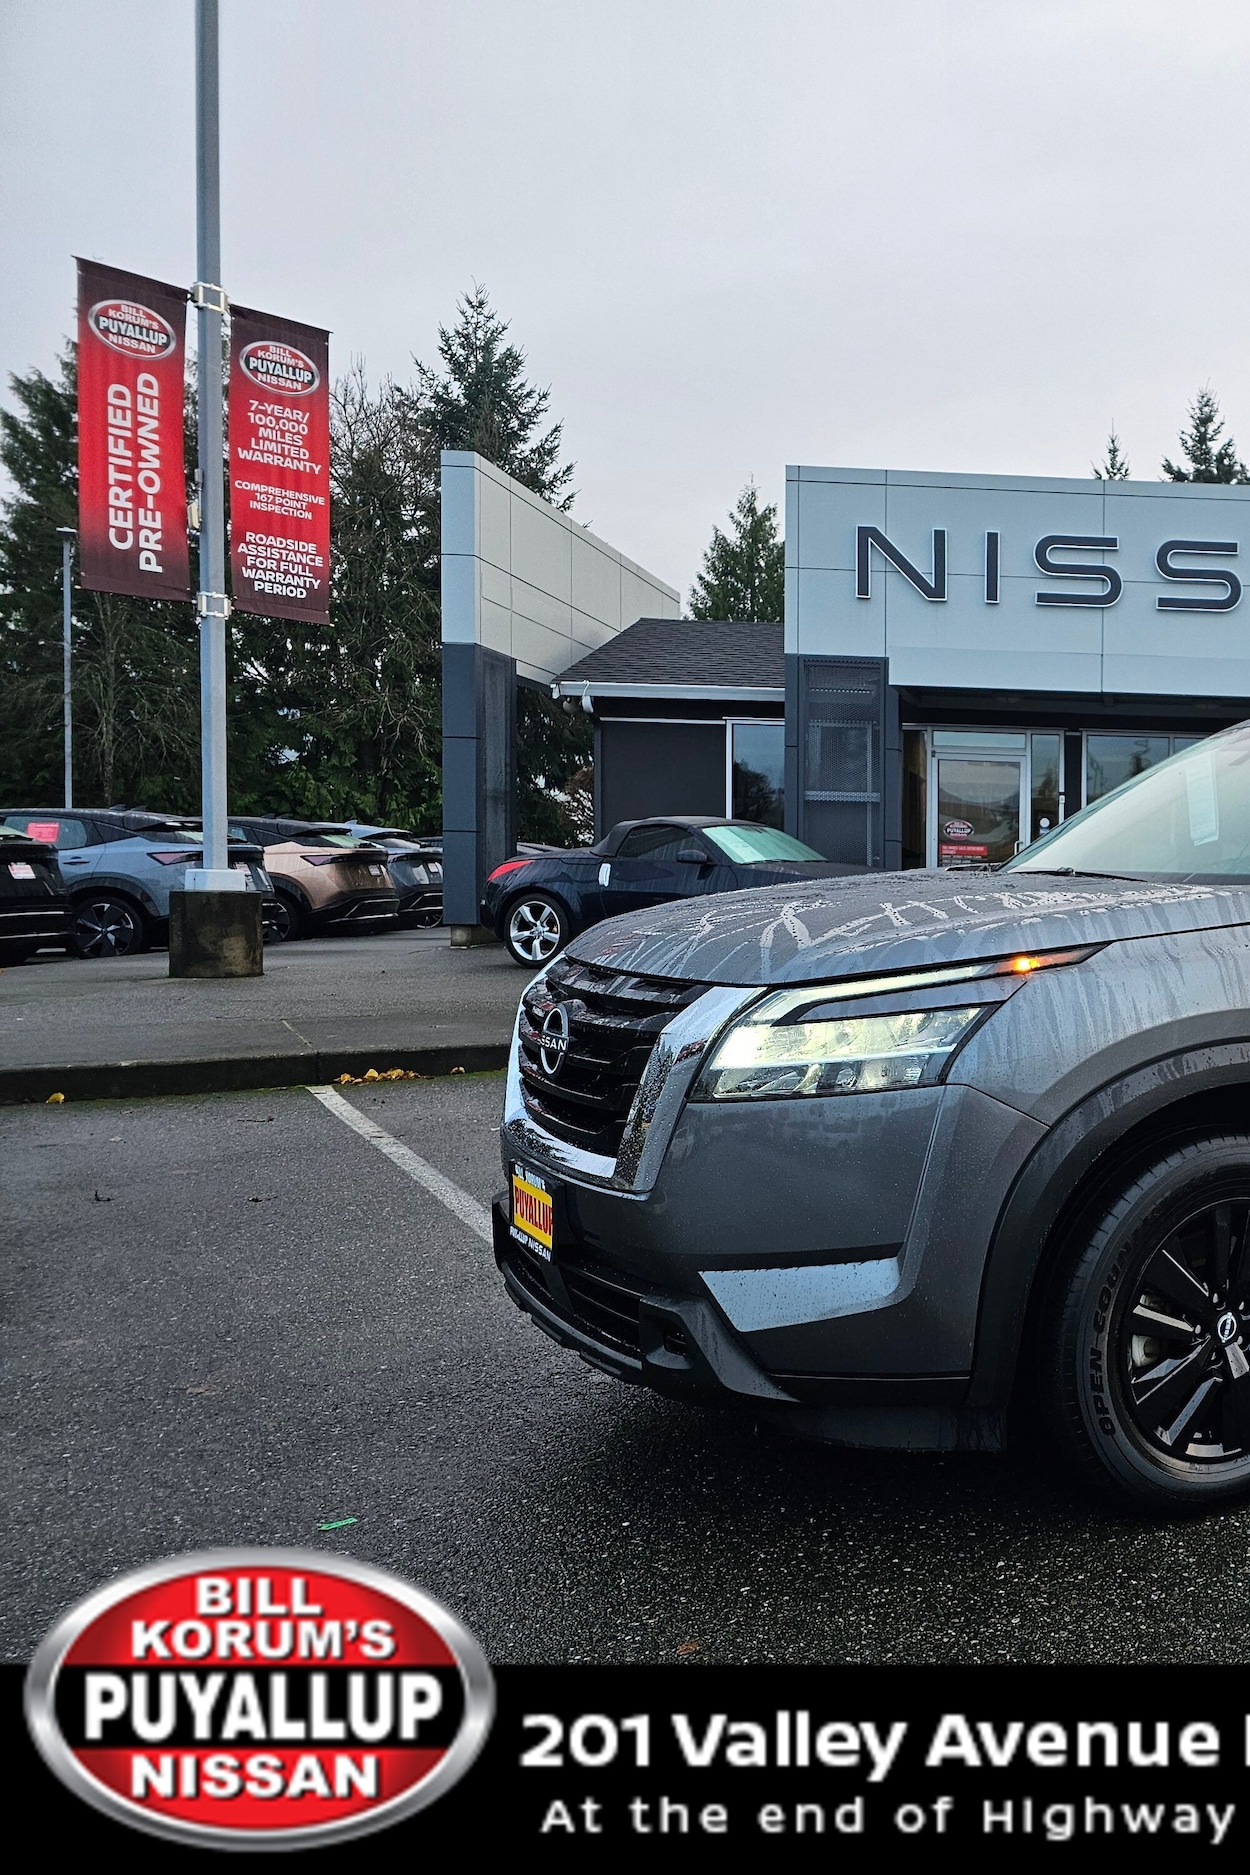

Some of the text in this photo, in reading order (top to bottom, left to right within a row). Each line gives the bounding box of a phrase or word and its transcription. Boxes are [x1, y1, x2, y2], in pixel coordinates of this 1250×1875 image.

[108, 309, 159, 329] KORUM'S
[121, 304, 146, 318] BILL
[99, 316, 167, 346] PUYALLUP
[109, 333, 156, 354] NISSAN
[269, 345, 292, 358] BILL
[249, 357, 312, 383] PUYALLUP
[258, 350, 304, 368] KORUM'S
[257, 373, 302, 390] NISSAN
[249, 400, 310, 423] 7-YEAR/
[247, 412, 308, 435] 100,000
[258, 427, 303, 446] MILES
[251, 438, 309, 460] LIMITED
[107, 383, 134, 550] CERTIFIED
[237, 447, 321, 475] WARRANTY
[137, 372, 163, 574] PRE-OWNED
[234, 480, 325, 505] COMPREHENSIVE
[255, 493, 308, 510] 167 POINT
[249, 501, 312, 520] INSPECTION
[245, 531, 317, 555] ROADSIDE
[237, 543, 324, 567] ASSISTANCE
[246, 556, 314, 577] FOR FULL
[242, 566, 321, 590] WARRANTY
[254, 581, 307, 599] PERIOD
